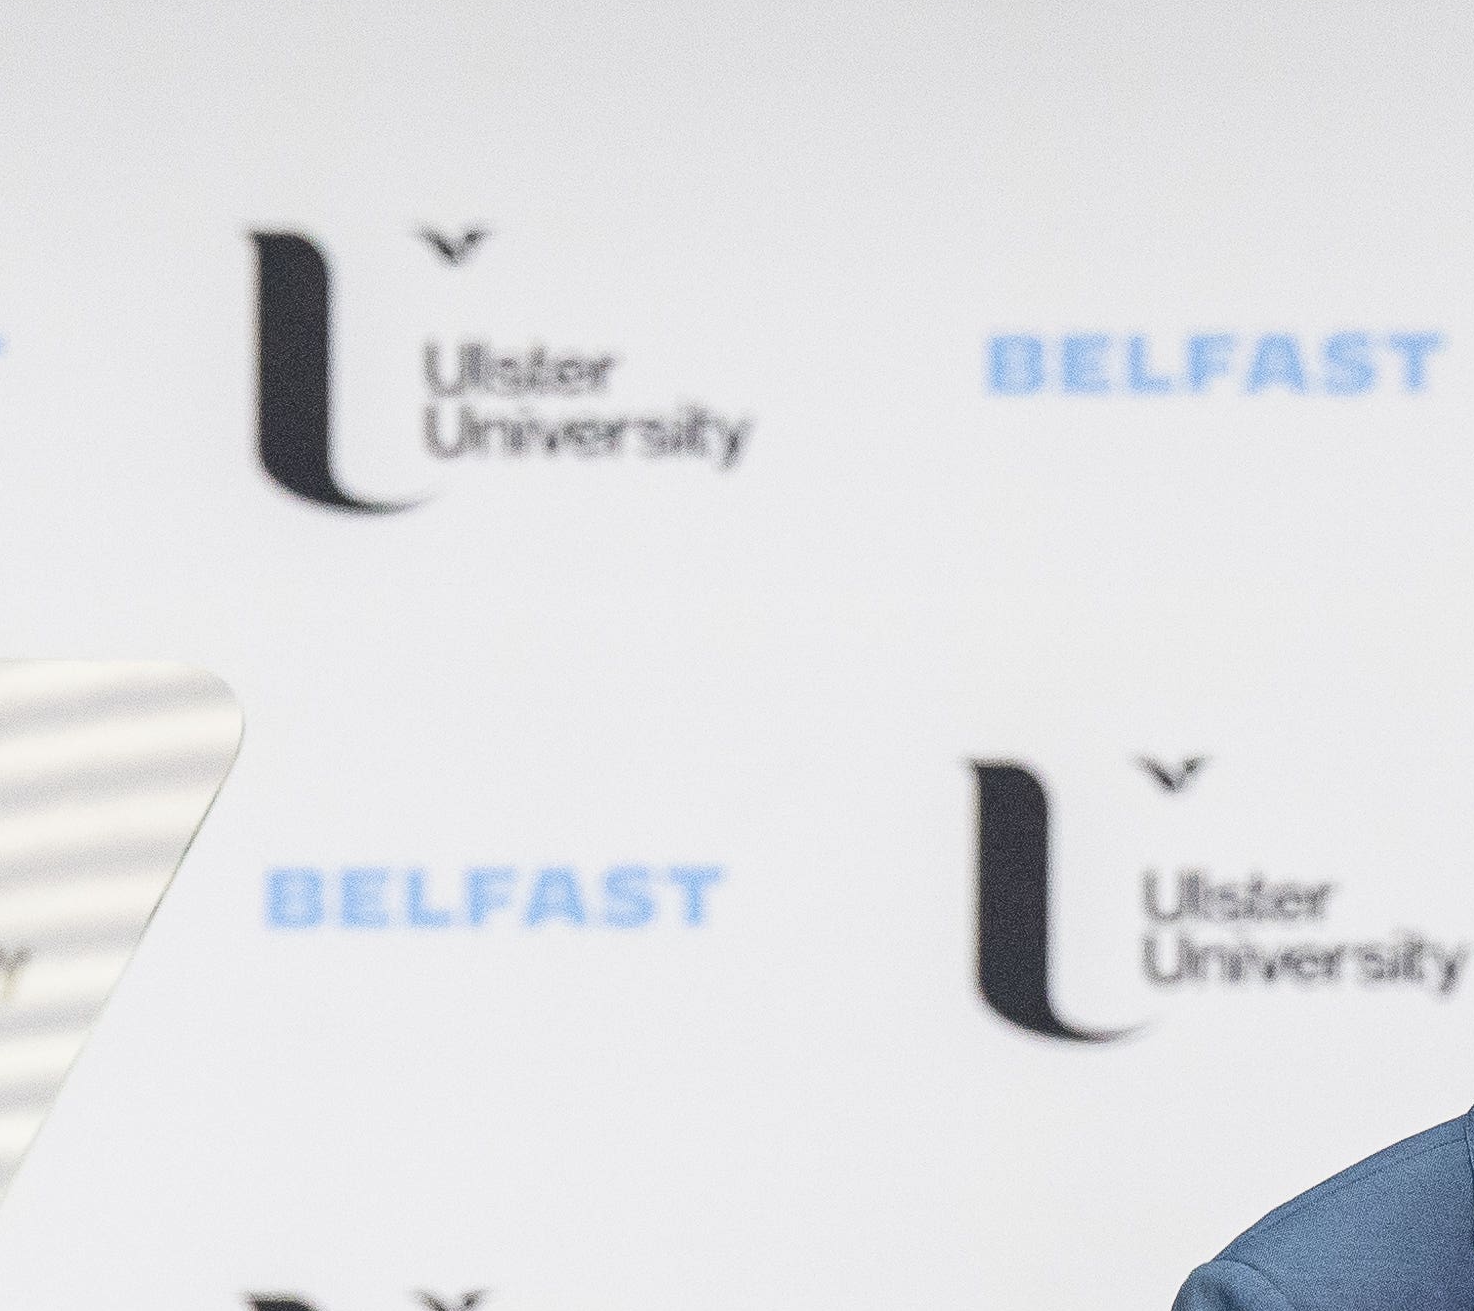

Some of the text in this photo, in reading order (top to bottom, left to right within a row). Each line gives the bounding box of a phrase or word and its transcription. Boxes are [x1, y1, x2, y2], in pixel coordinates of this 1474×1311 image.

[423, 339, 616, 397] Ulster
[983, 329, 1443, 397] BELFAST
[423, 405, 748, 467] University
[262, 862, 724, 931] BELFAST
[1142, 870, 1334, 924] Ulster
[1141, 934, 1466, 995] University
